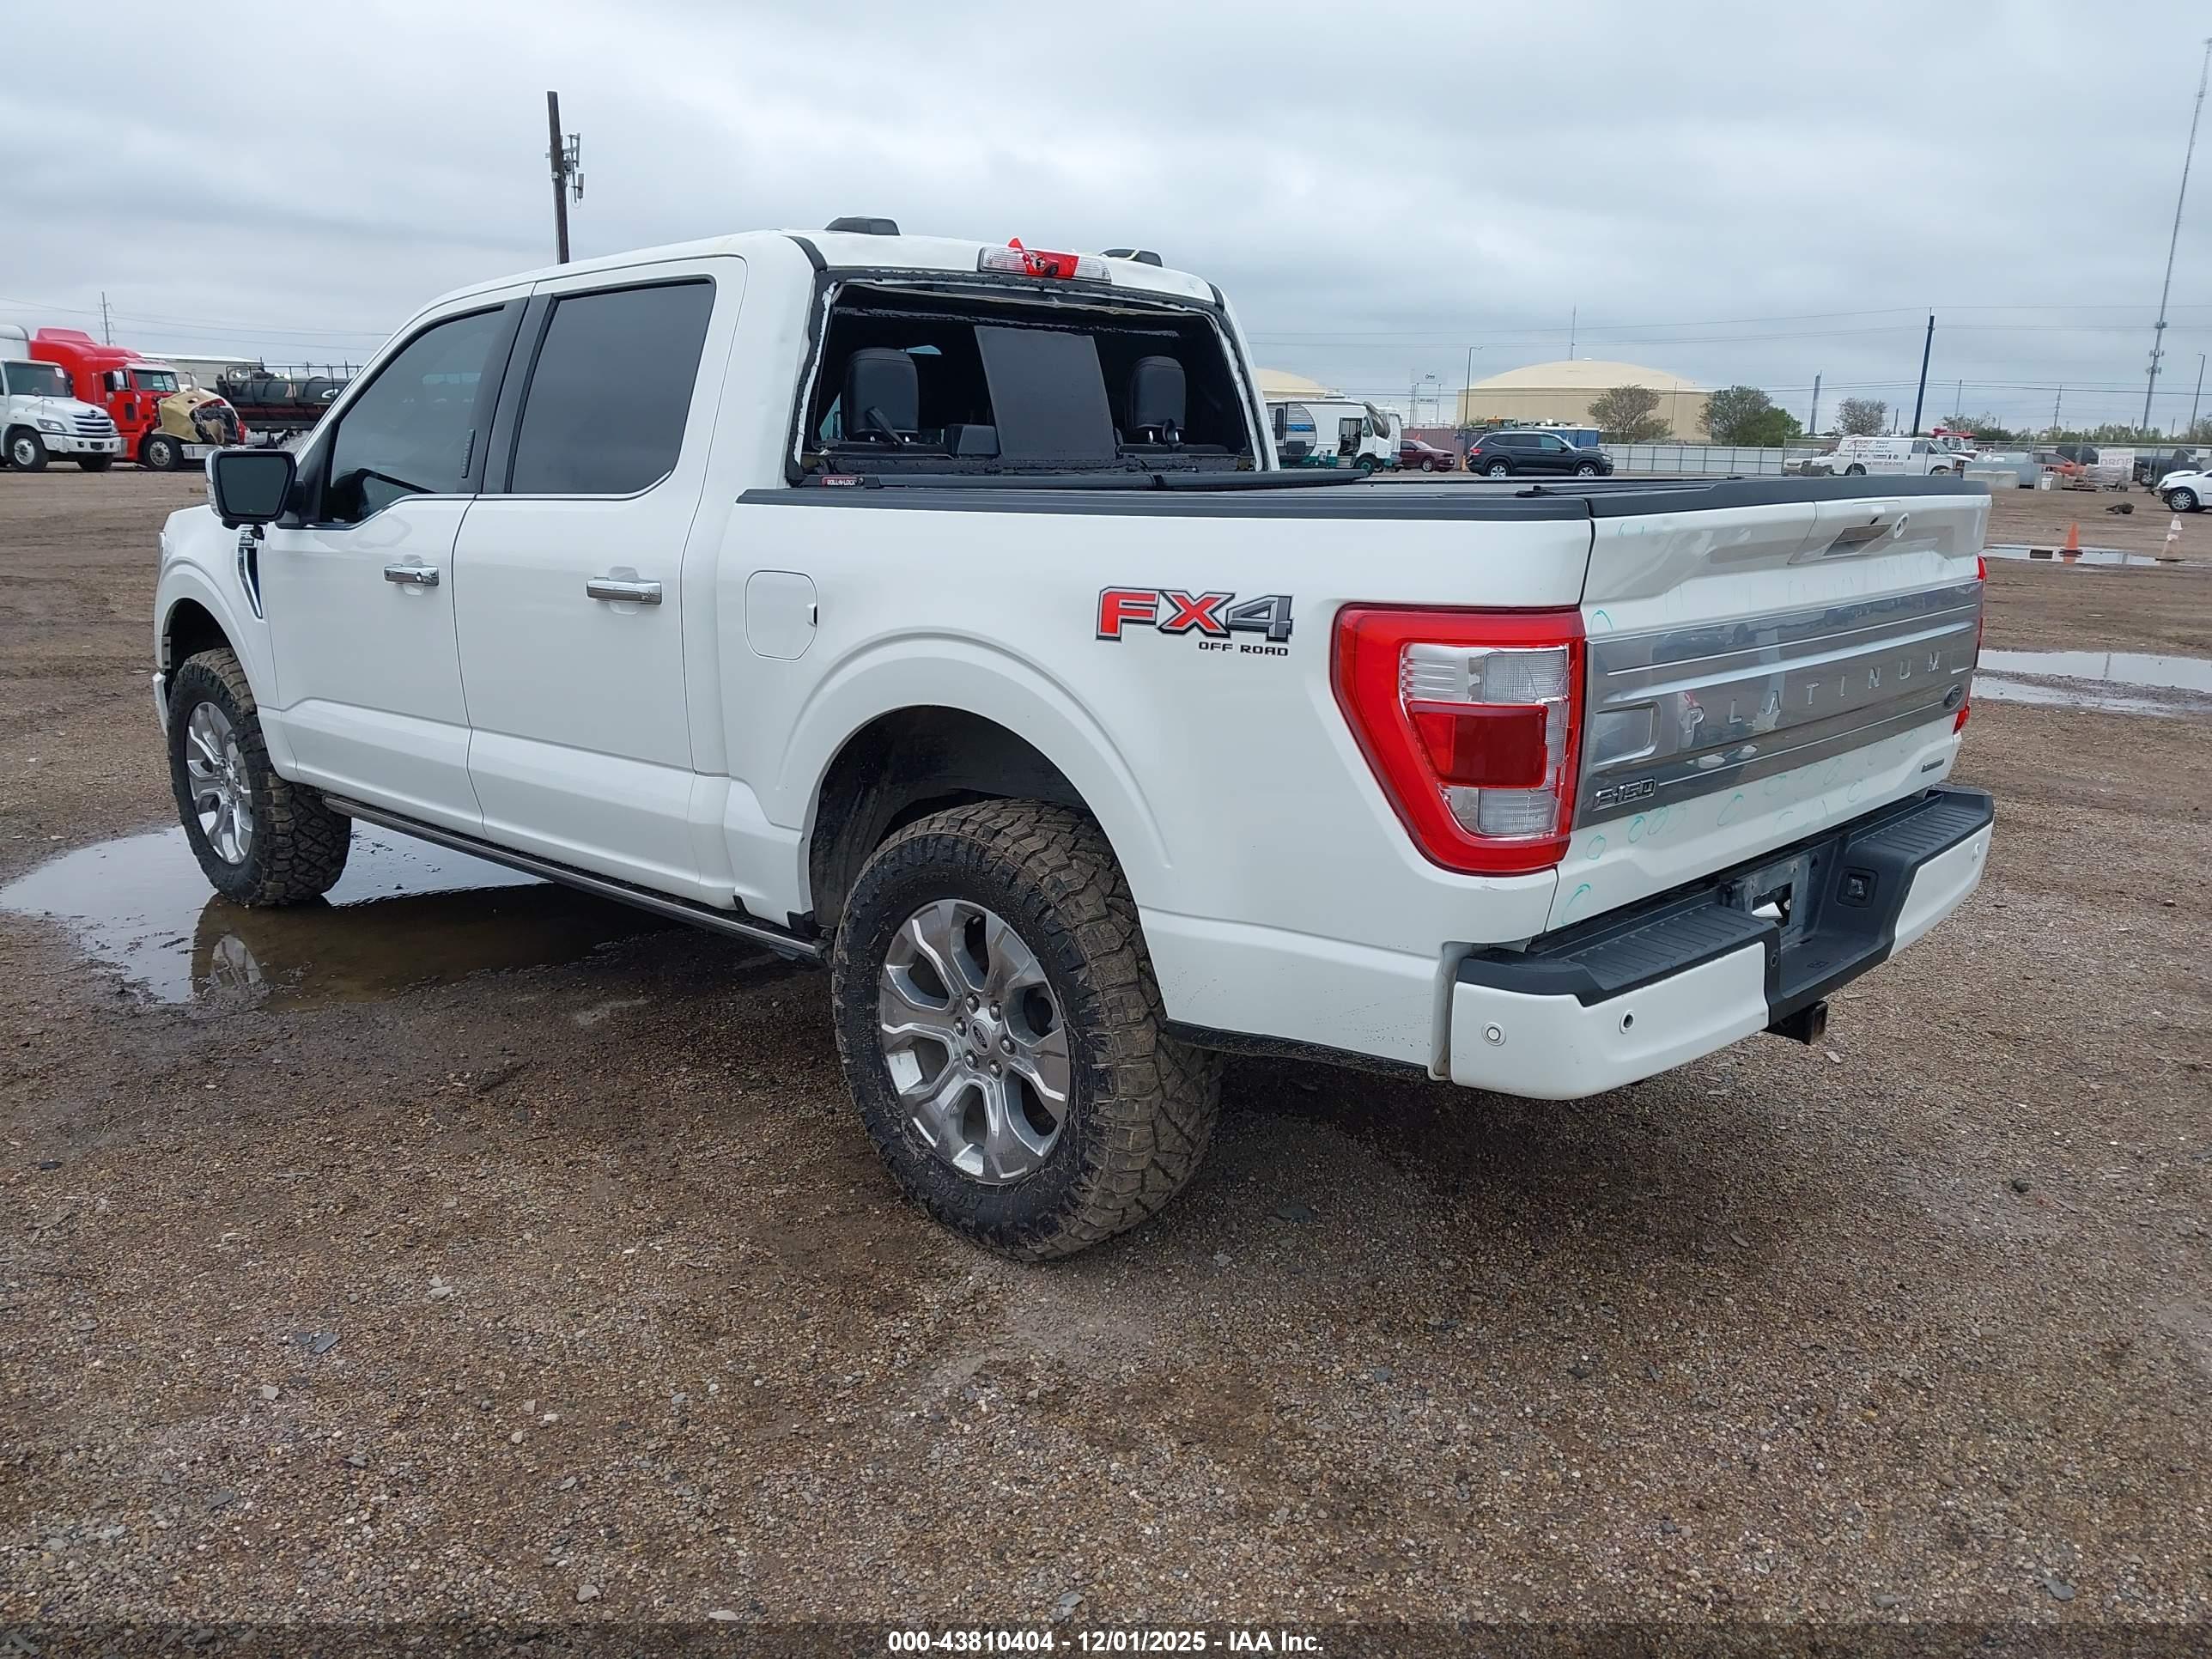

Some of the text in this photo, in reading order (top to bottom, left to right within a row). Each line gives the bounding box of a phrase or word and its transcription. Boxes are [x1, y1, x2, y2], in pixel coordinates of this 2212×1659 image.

[1096, 586, 1293, 643] FX4
[1198, 641, 1289, 657] OFF ROAD
[1685, 650, 1942, 733] PLATINUM
[1592, 777, 1656, 810] F-150
